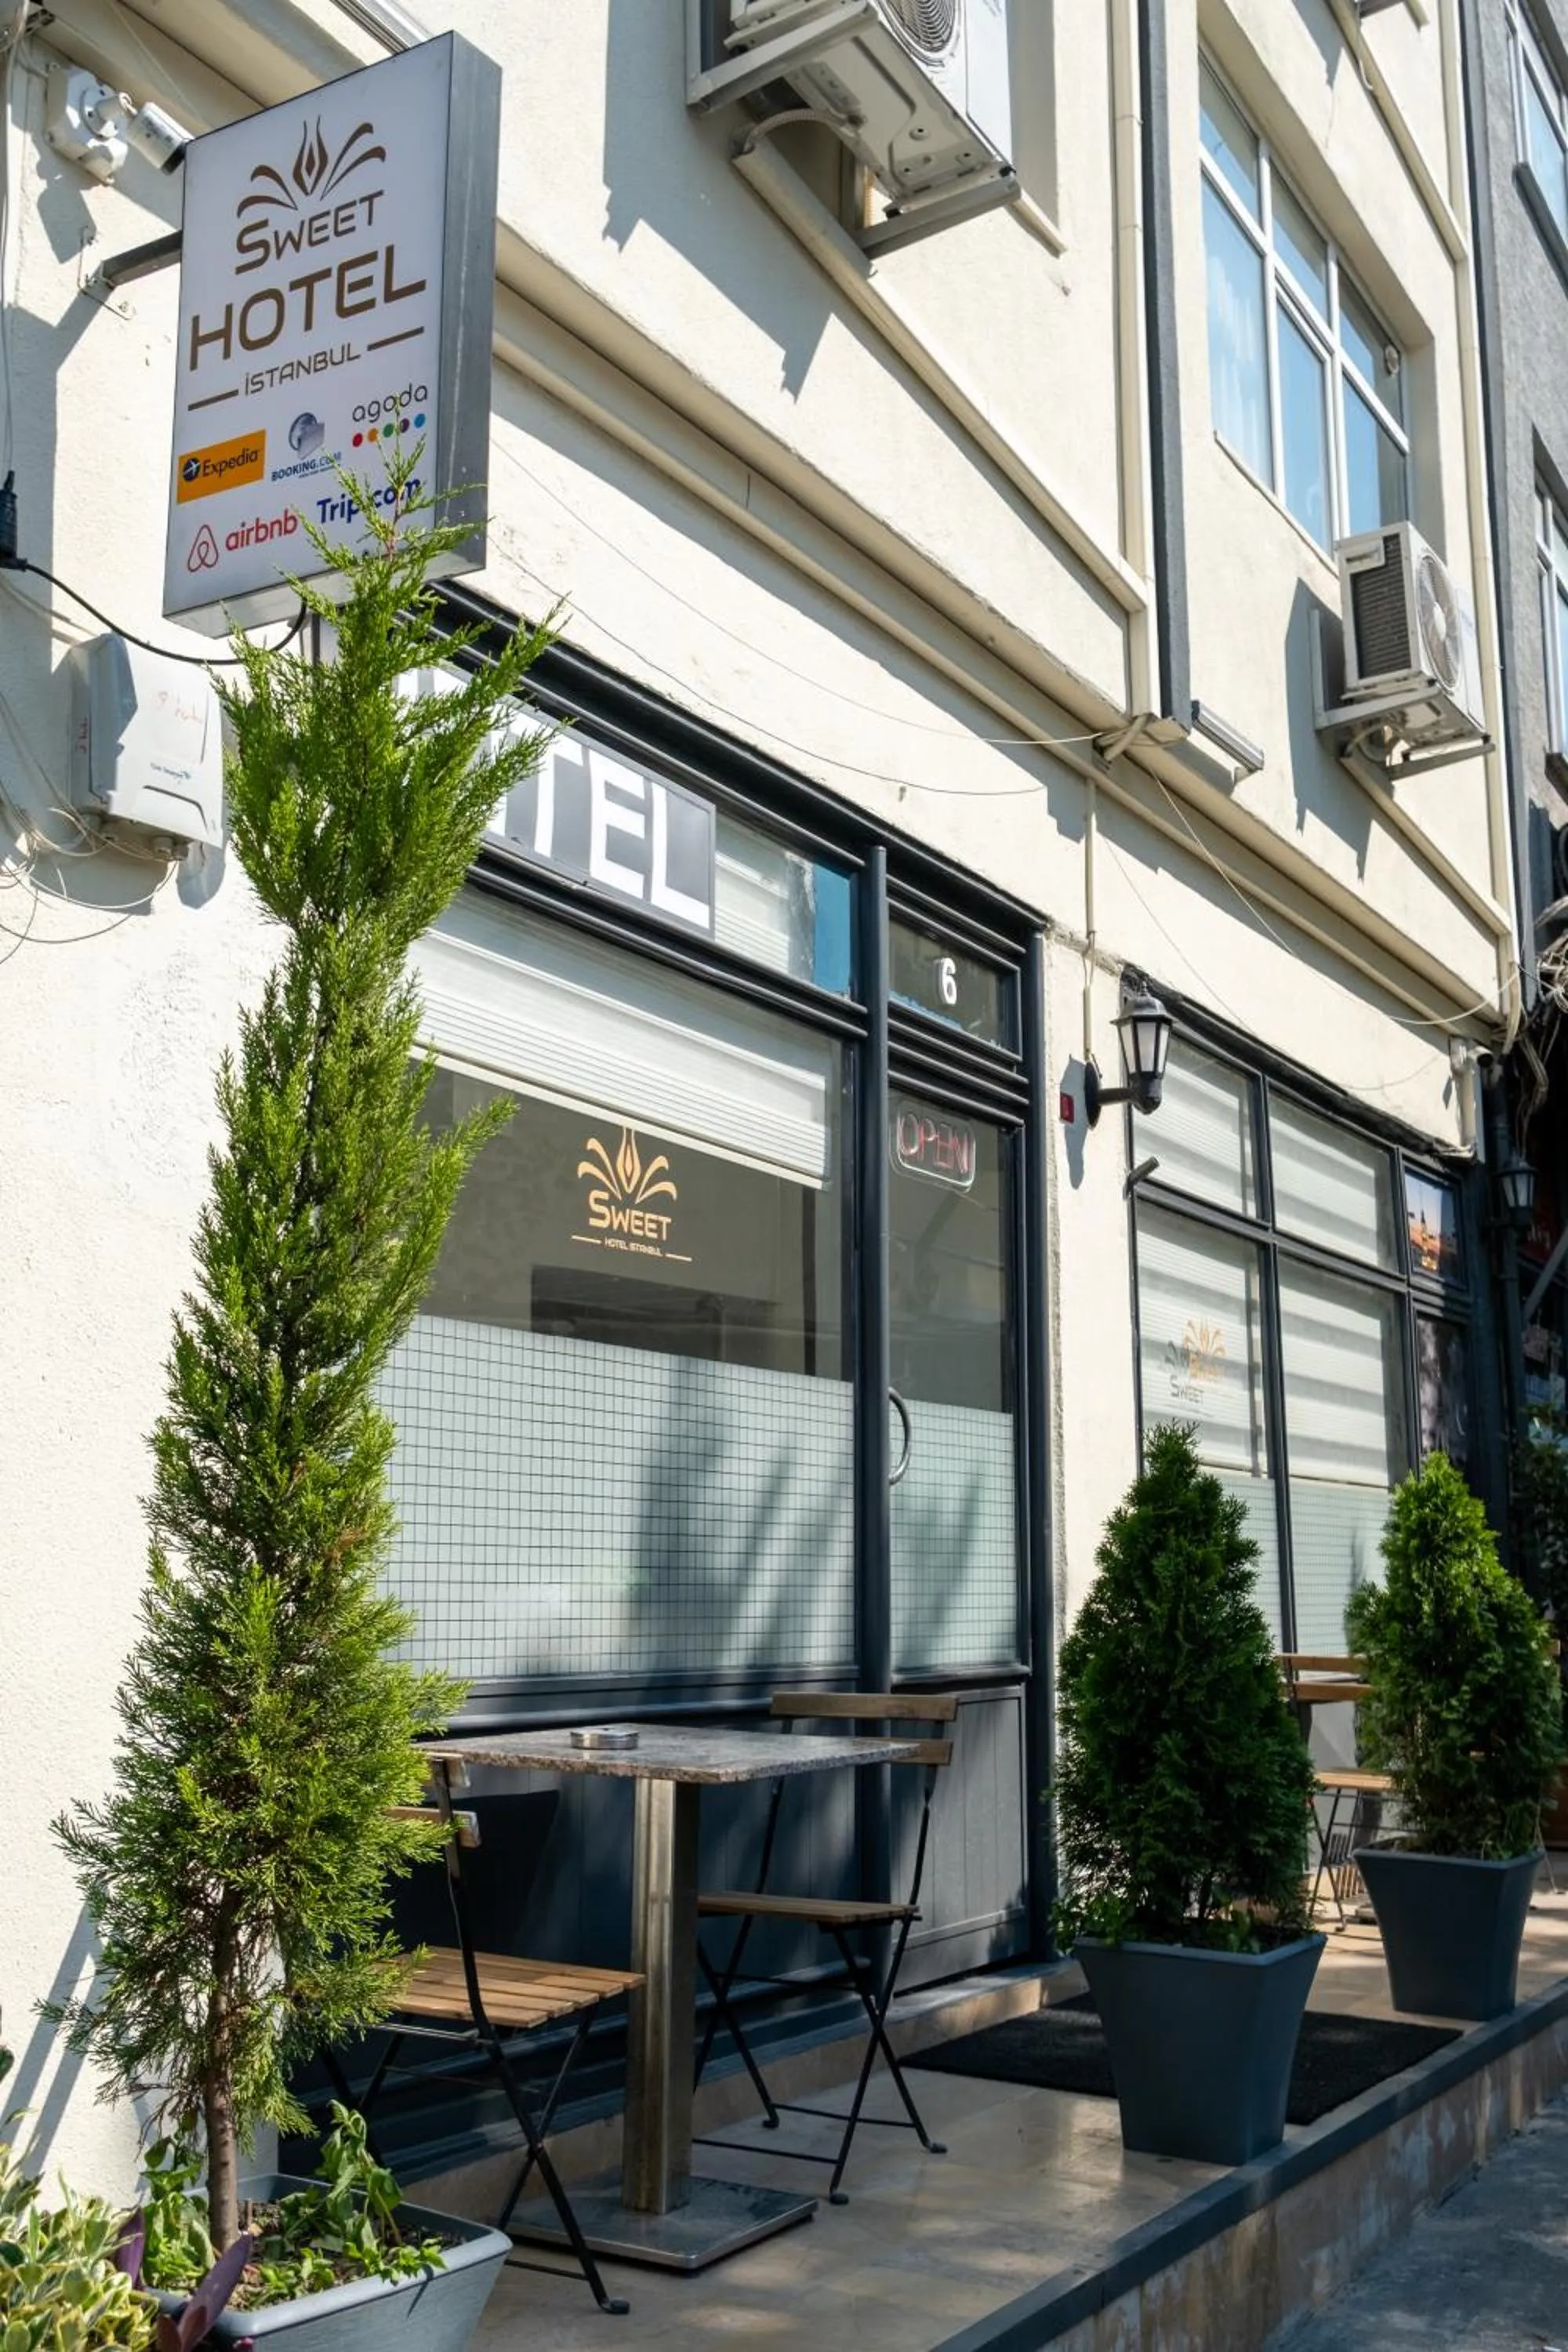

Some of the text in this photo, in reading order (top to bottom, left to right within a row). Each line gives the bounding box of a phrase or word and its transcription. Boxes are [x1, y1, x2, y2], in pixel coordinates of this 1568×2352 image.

[235, 190, 384, 274] SWEET
[190, 245, 426, 371] HOTEL
[352, 382, 427, 423] agoda
[202, 448, 258, 477] Expedia
[225, 508, 298, 550] airbnb
[394, 666, 710, 930] TEL
[939, 957, 957, 1005] 6
[900, 1113, 969, 1174] OPEN
[589, 1189, 672, 1240] SWEET
[604, 1236, 628, 1250] HOTEL
